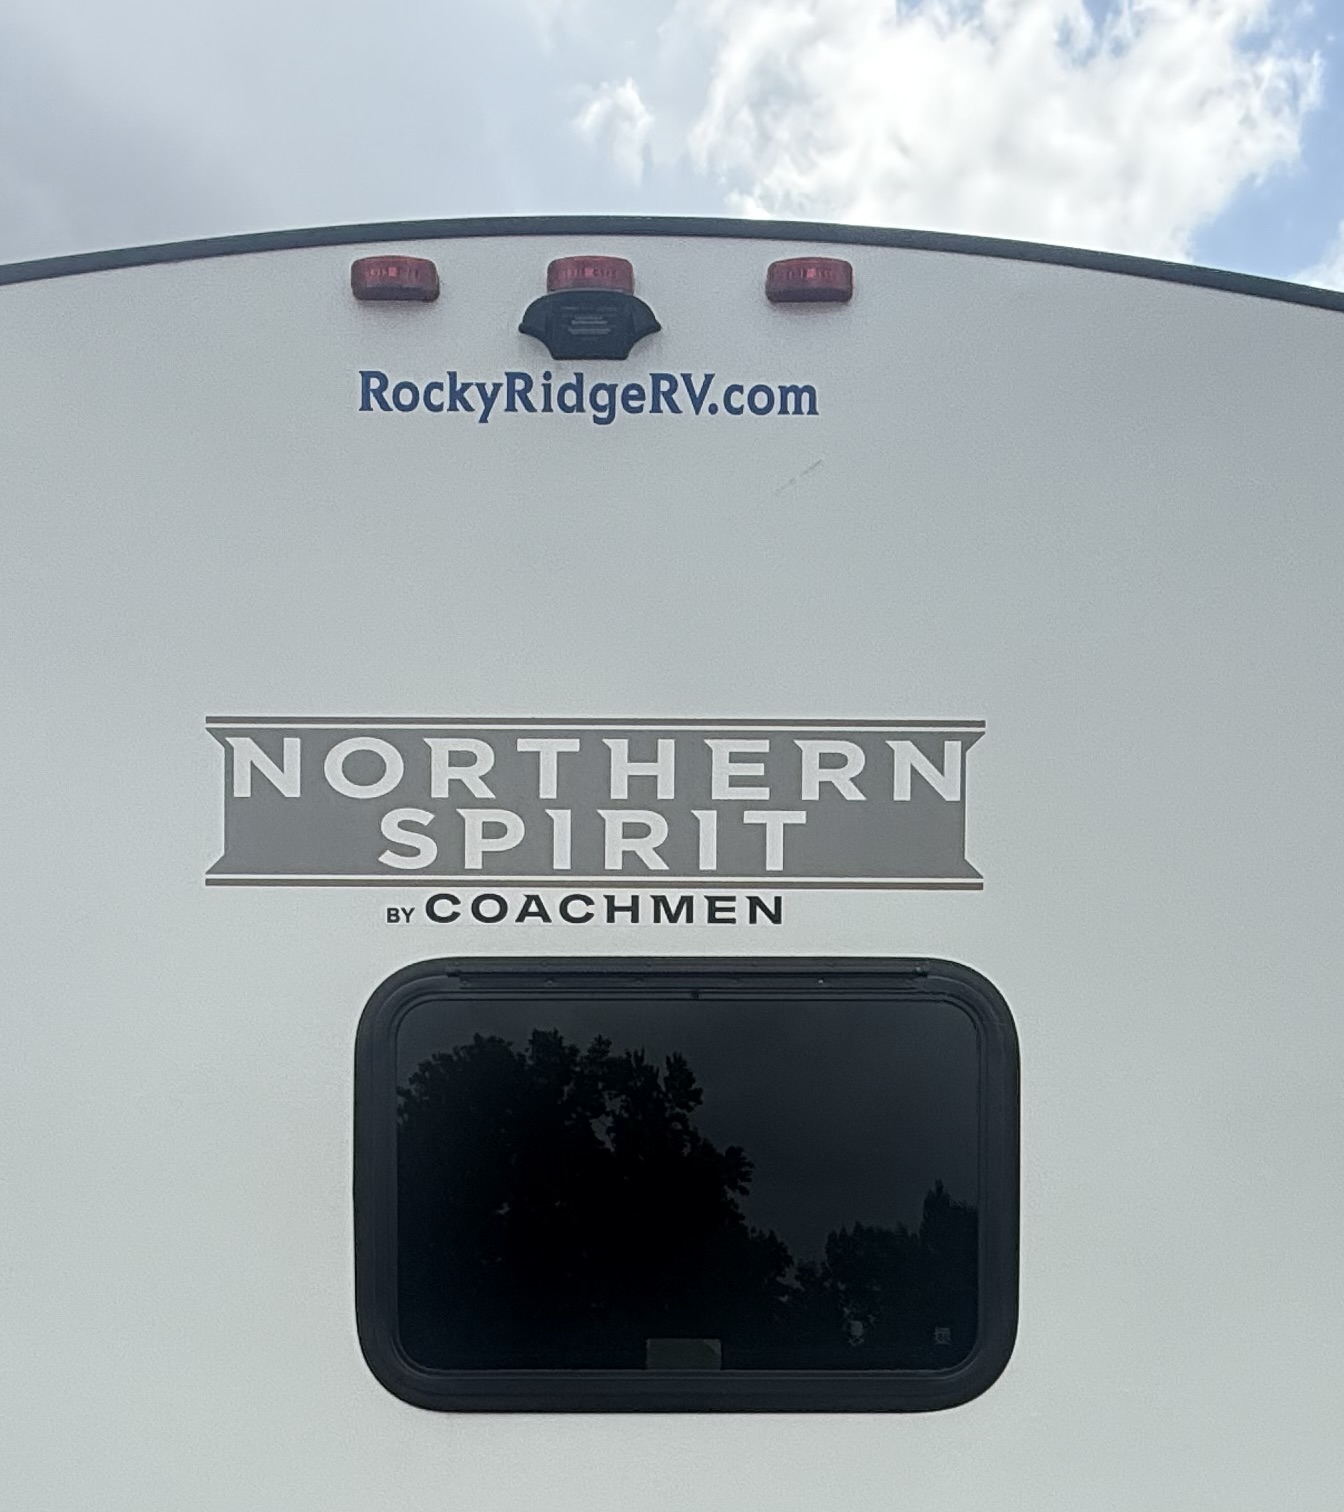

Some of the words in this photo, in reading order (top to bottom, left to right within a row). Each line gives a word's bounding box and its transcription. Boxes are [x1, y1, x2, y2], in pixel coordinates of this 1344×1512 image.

[358, 370, 820, 426] RockyRidgeRV.com
[225, 735, 963, 802] NORTHERN
[377, 807, 807, 872] SPIRIT
[386, 906, 416, 924] BY
[424, 892, 784, 926] COACHMEN
